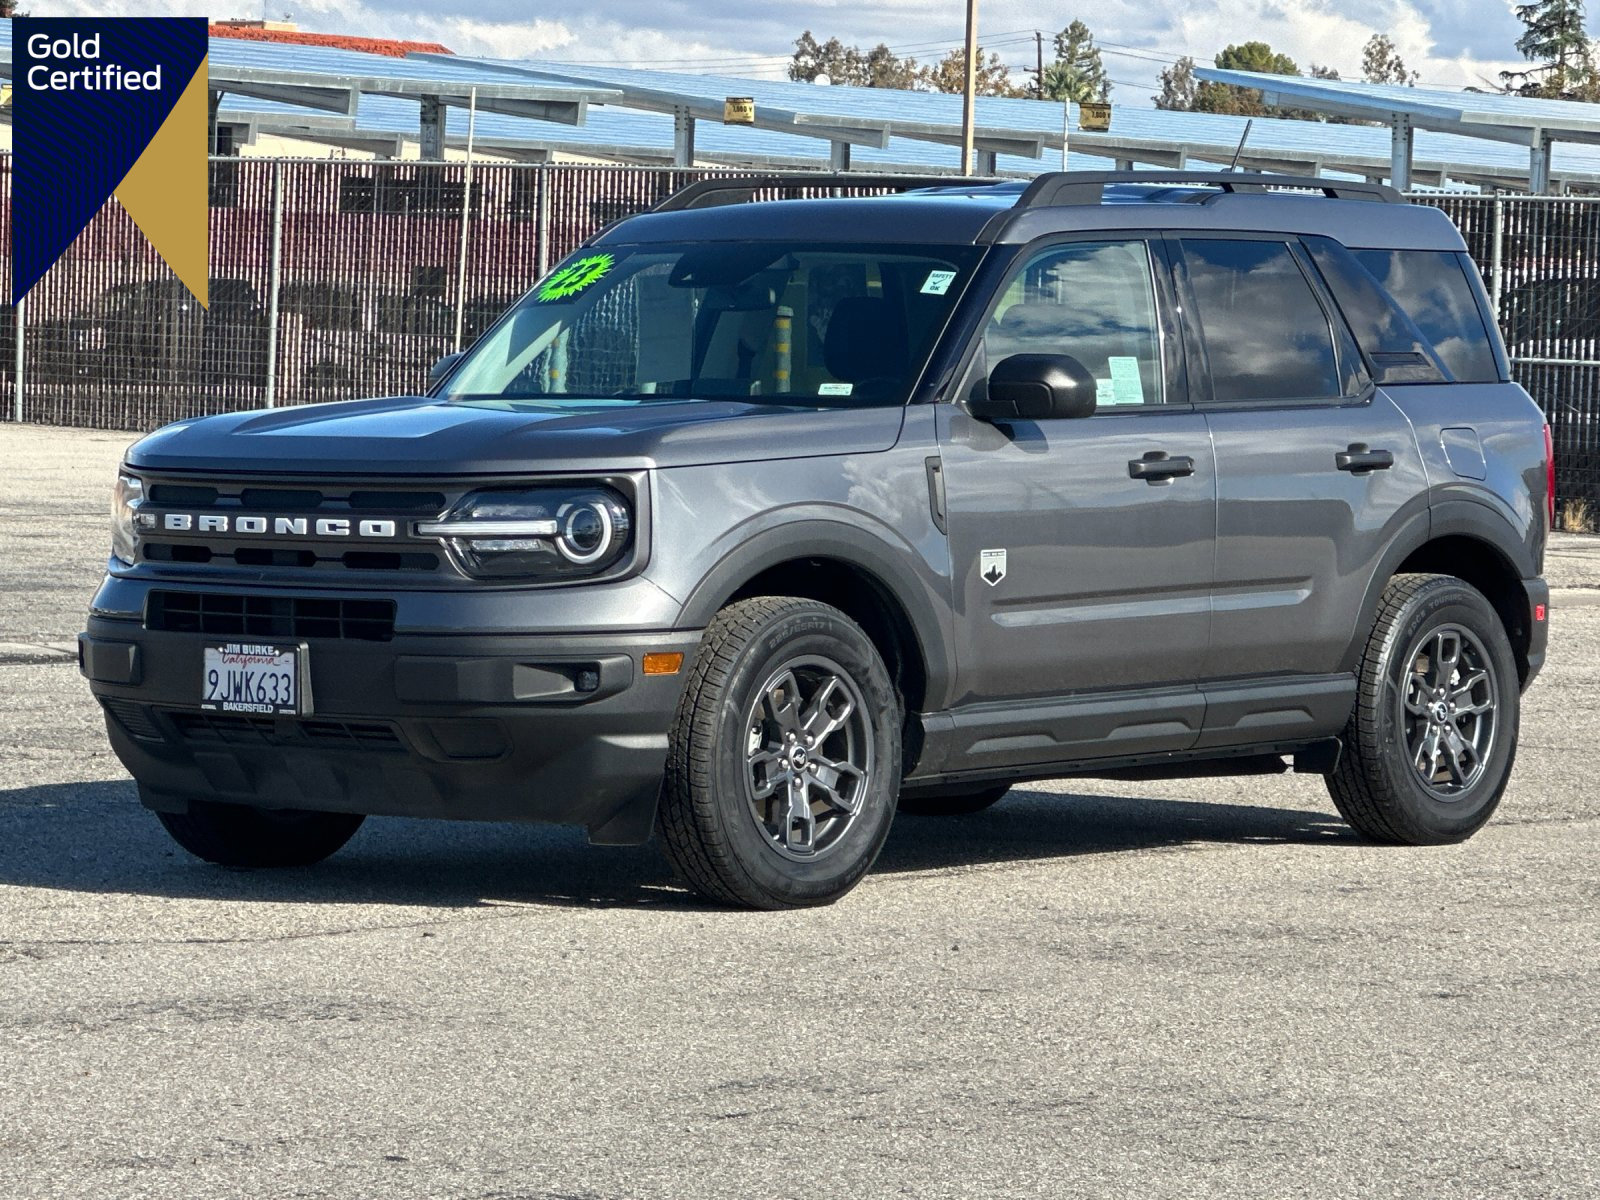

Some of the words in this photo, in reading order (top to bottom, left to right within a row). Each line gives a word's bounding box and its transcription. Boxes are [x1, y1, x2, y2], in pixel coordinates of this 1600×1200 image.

[164, 513, 396, 538] BRONCO
[224, 643, 241, 654] JIM
[242, 644, 275, 656] BURKE
[221, 652, 281, 669] California
[208, 669, 292, 704] 9JWK633
[222, 702, 274, 714] BAKERSFIELD
